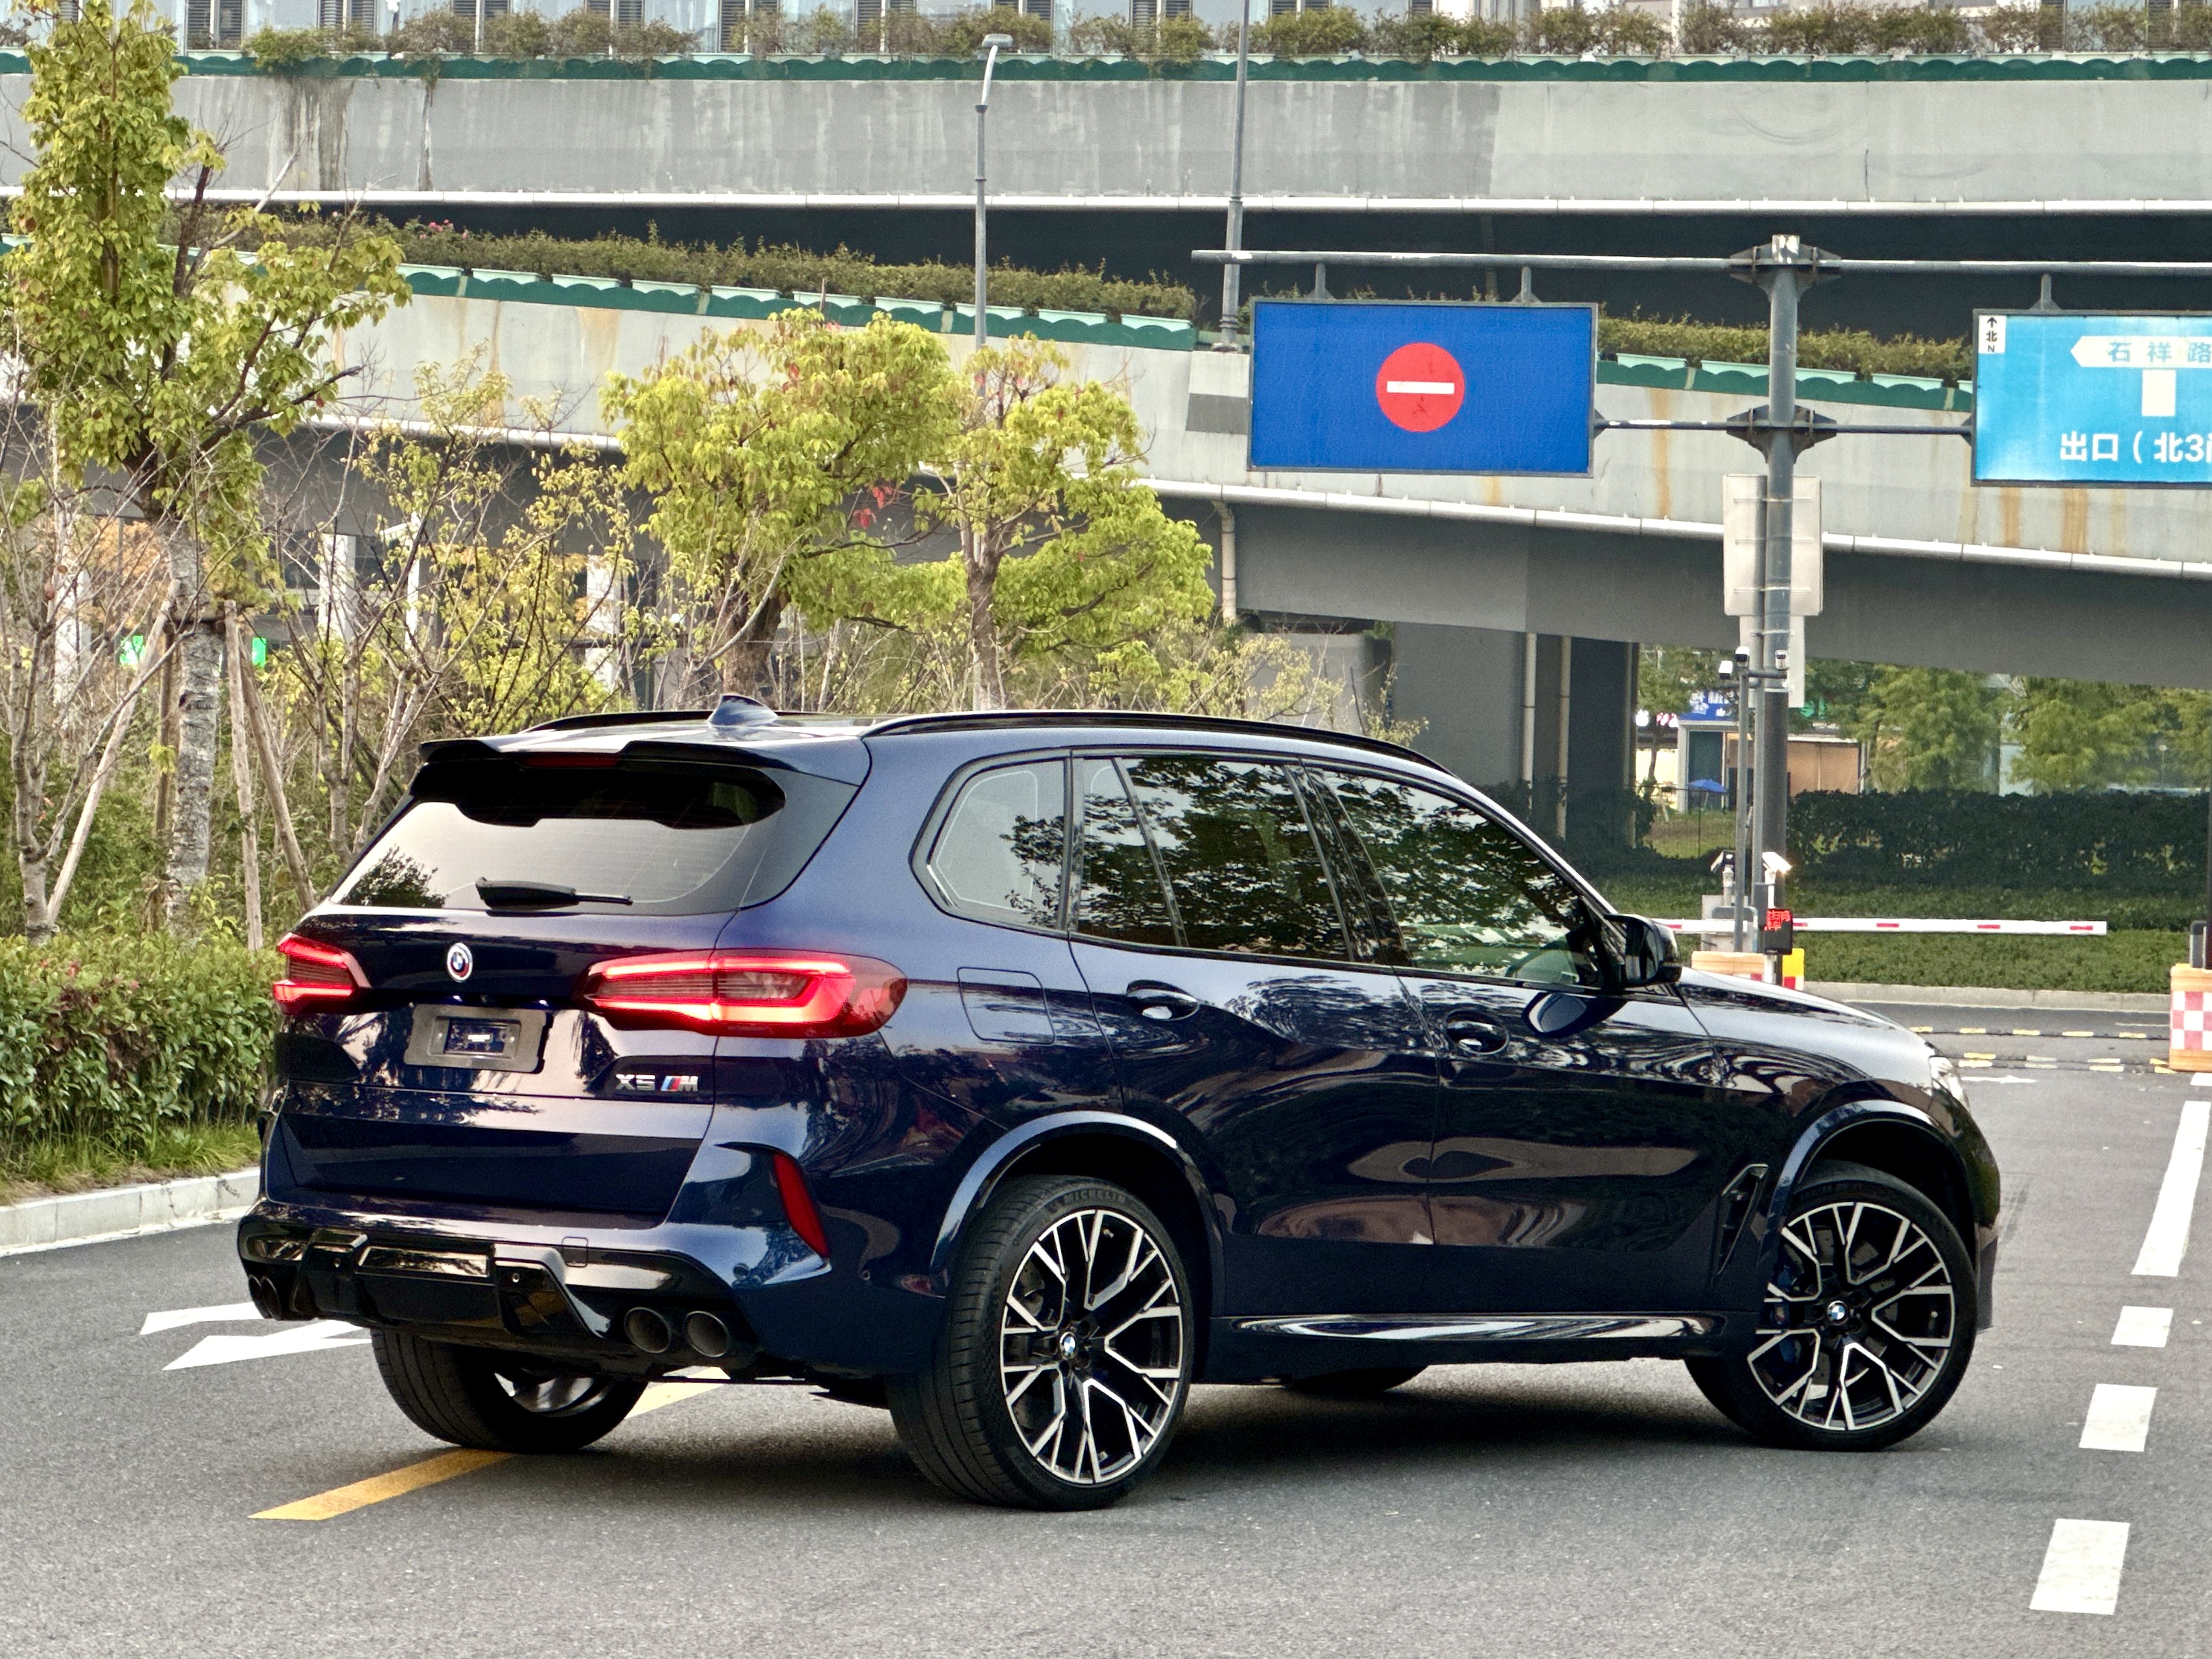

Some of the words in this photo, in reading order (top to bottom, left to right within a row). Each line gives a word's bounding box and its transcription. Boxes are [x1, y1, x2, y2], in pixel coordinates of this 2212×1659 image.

[1986, 331, 1998, 342] 北
[1987, 345, 1995, 353] N
[2107, 340, 2211, 363] 石祥路
[2059, 430, 2212, 463] 出口（北3
[616, 1074, 655, 1091] X5
[675, 1075, 698, 1092] M
